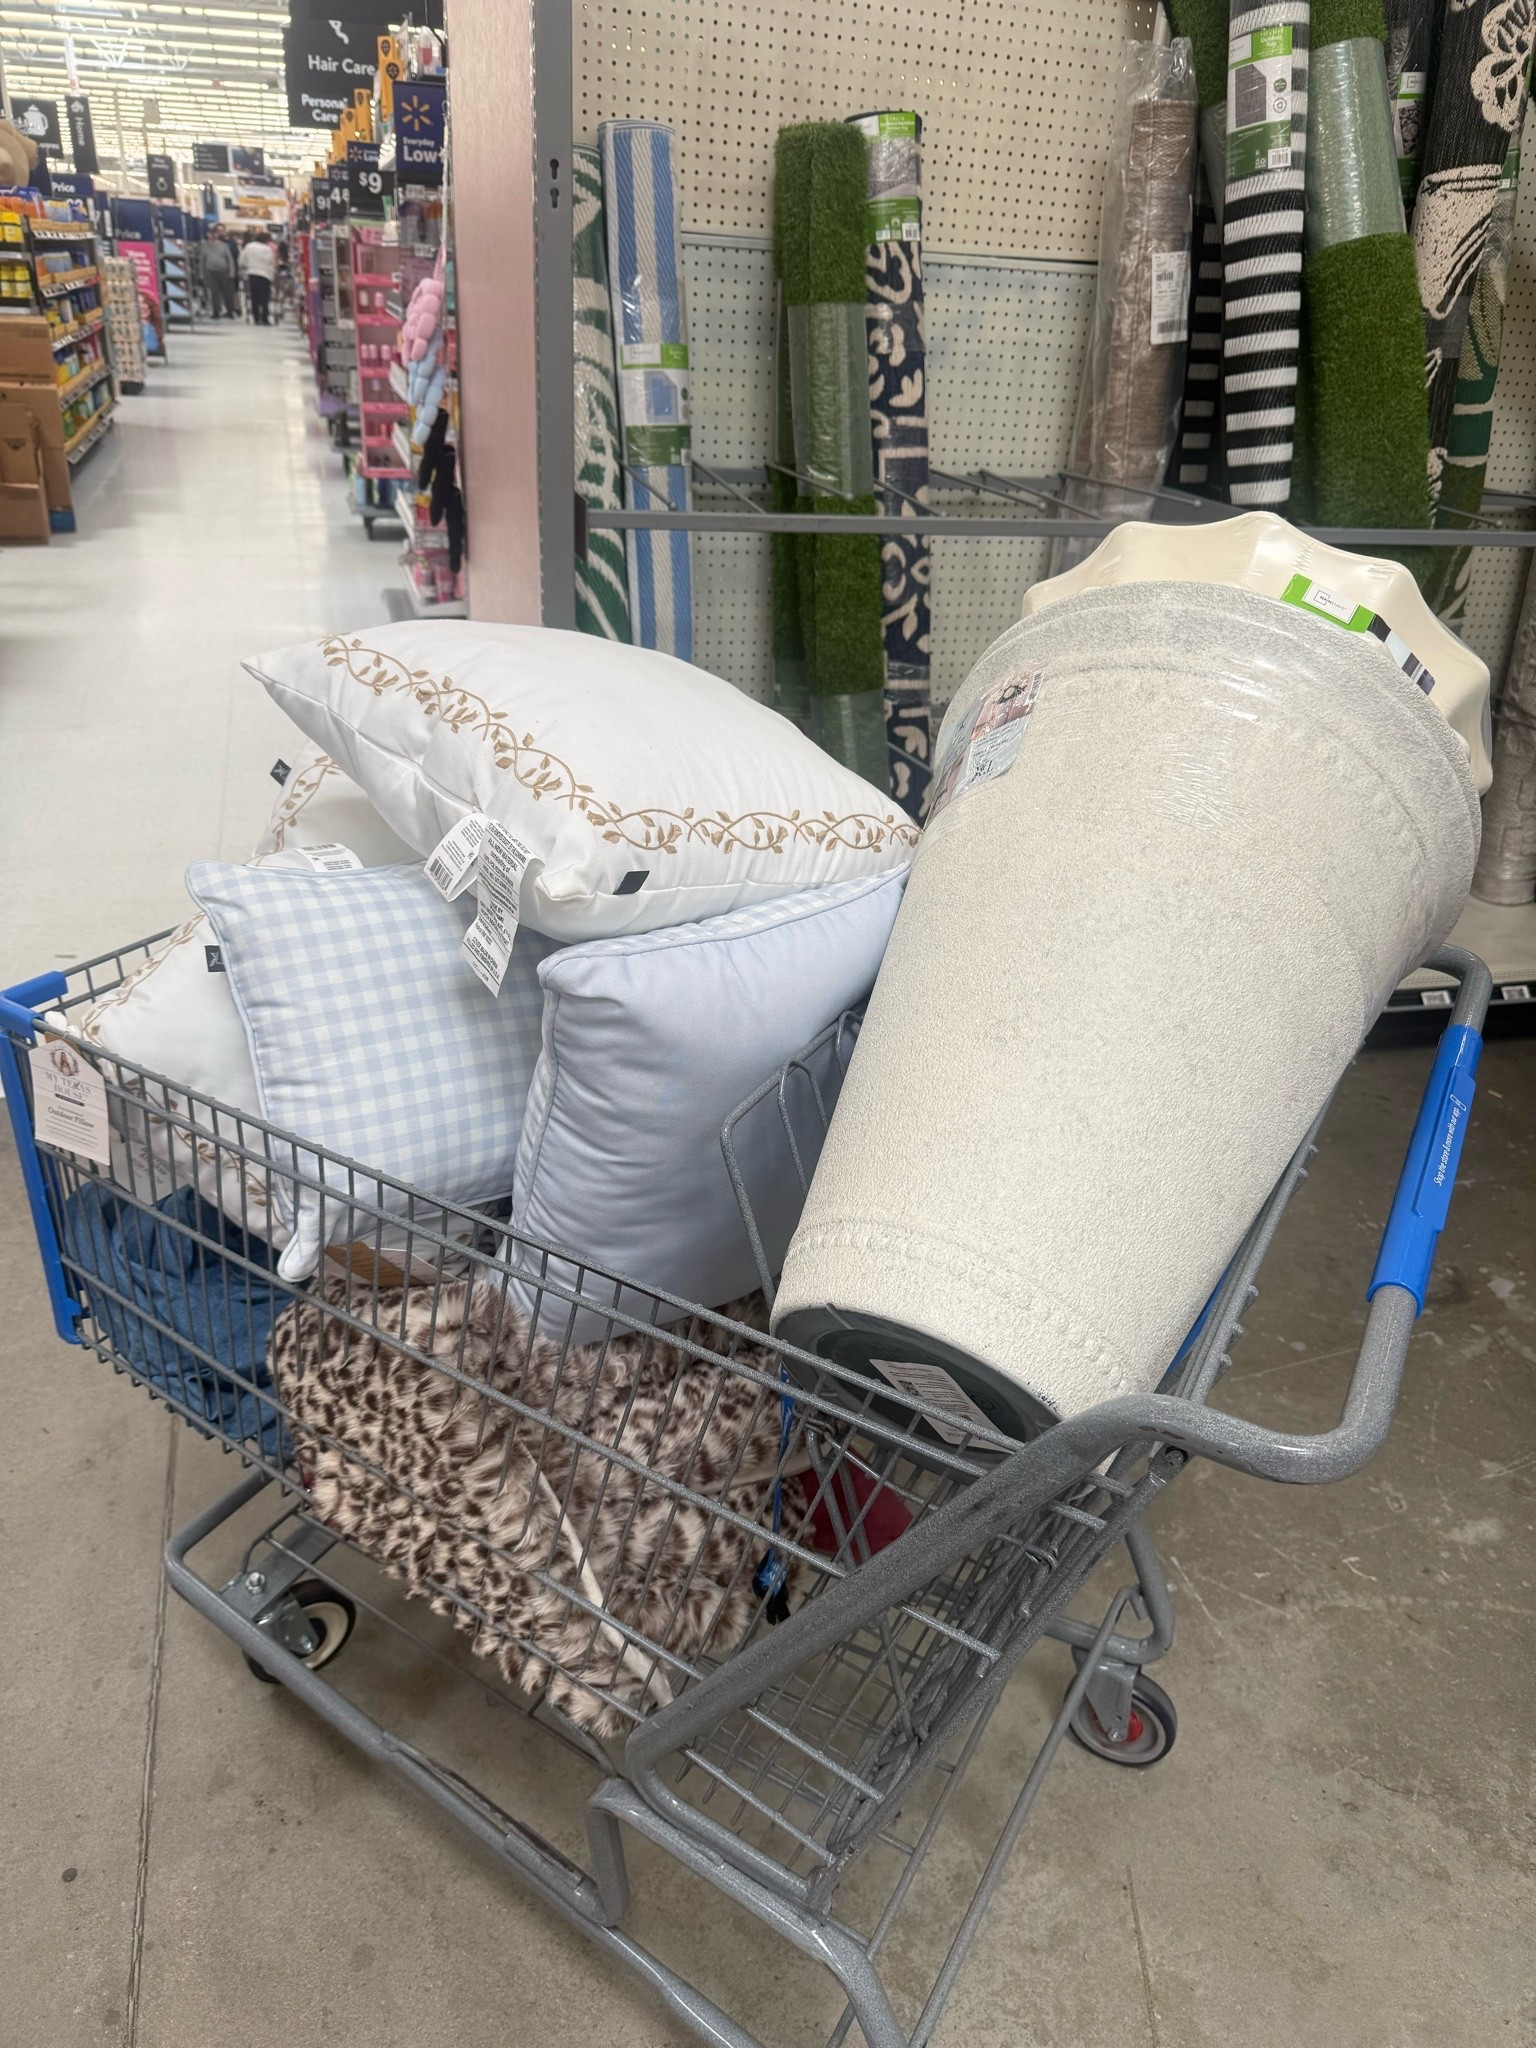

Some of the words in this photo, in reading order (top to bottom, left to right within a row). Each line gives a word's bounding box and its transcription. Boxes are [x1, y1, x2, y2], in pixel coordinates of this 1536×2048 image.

[308, 54, 339, 72] Hair
[342, 58, 376, 76] Care
[312, 109, 338, 123] Care
[75, 117, 85, 146] Home
[402, 137, 435, 148] Everyday
[403, 146, 438, 163] Low
[52, 182, 76, 194] Price
[358, 172, 382, 194] $9
[115, 228, 142, 240] Price
[46, 1072, 58, 1083] MY
[62, 1077, 92, 1095] TEXAS
[54, 1083, 84, 1100] HOUSE
[48, 1106, 74, 1121] Outdoor
[74, 1114, 94, 1128] Pillow
[1441, 1150, 1449, 1164] store
[1438, 1163, 1446, 1173] the
[1434, 1172, 1445, 1186] Shop
